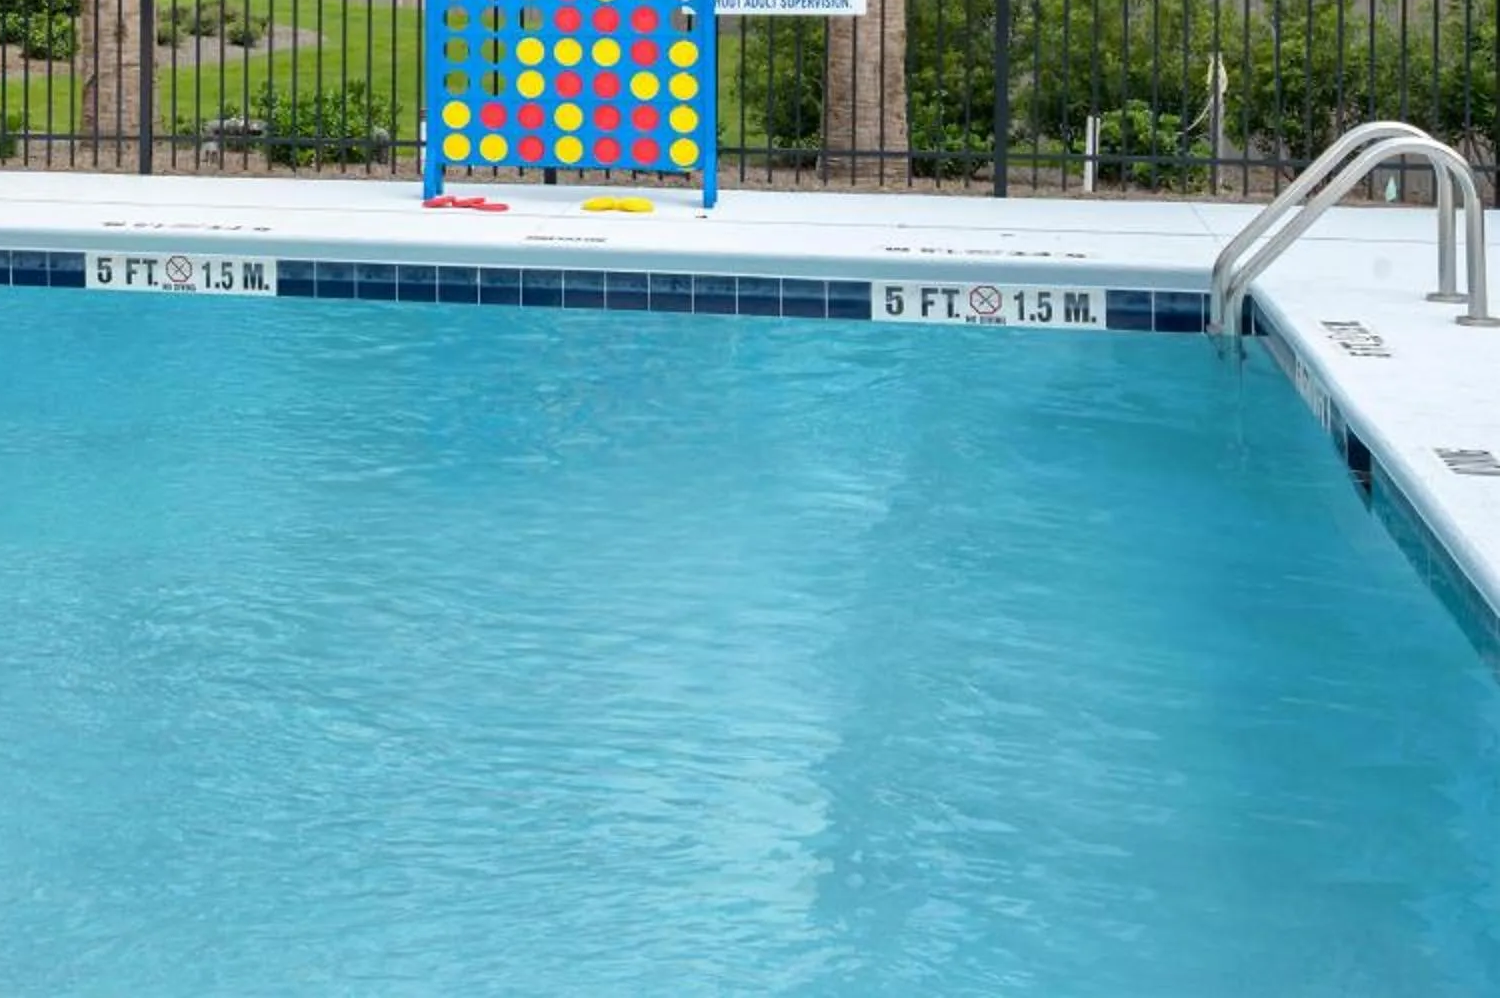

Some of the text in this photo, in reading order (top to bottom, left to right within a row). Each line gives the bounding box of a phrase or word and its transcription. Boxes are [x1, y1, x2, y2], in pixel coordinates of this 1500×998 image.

[97, 257, 270, 291] 5 FT. 1.5 M.
[885, 285, 1097, 324] 5 FT. 1.5 M.
